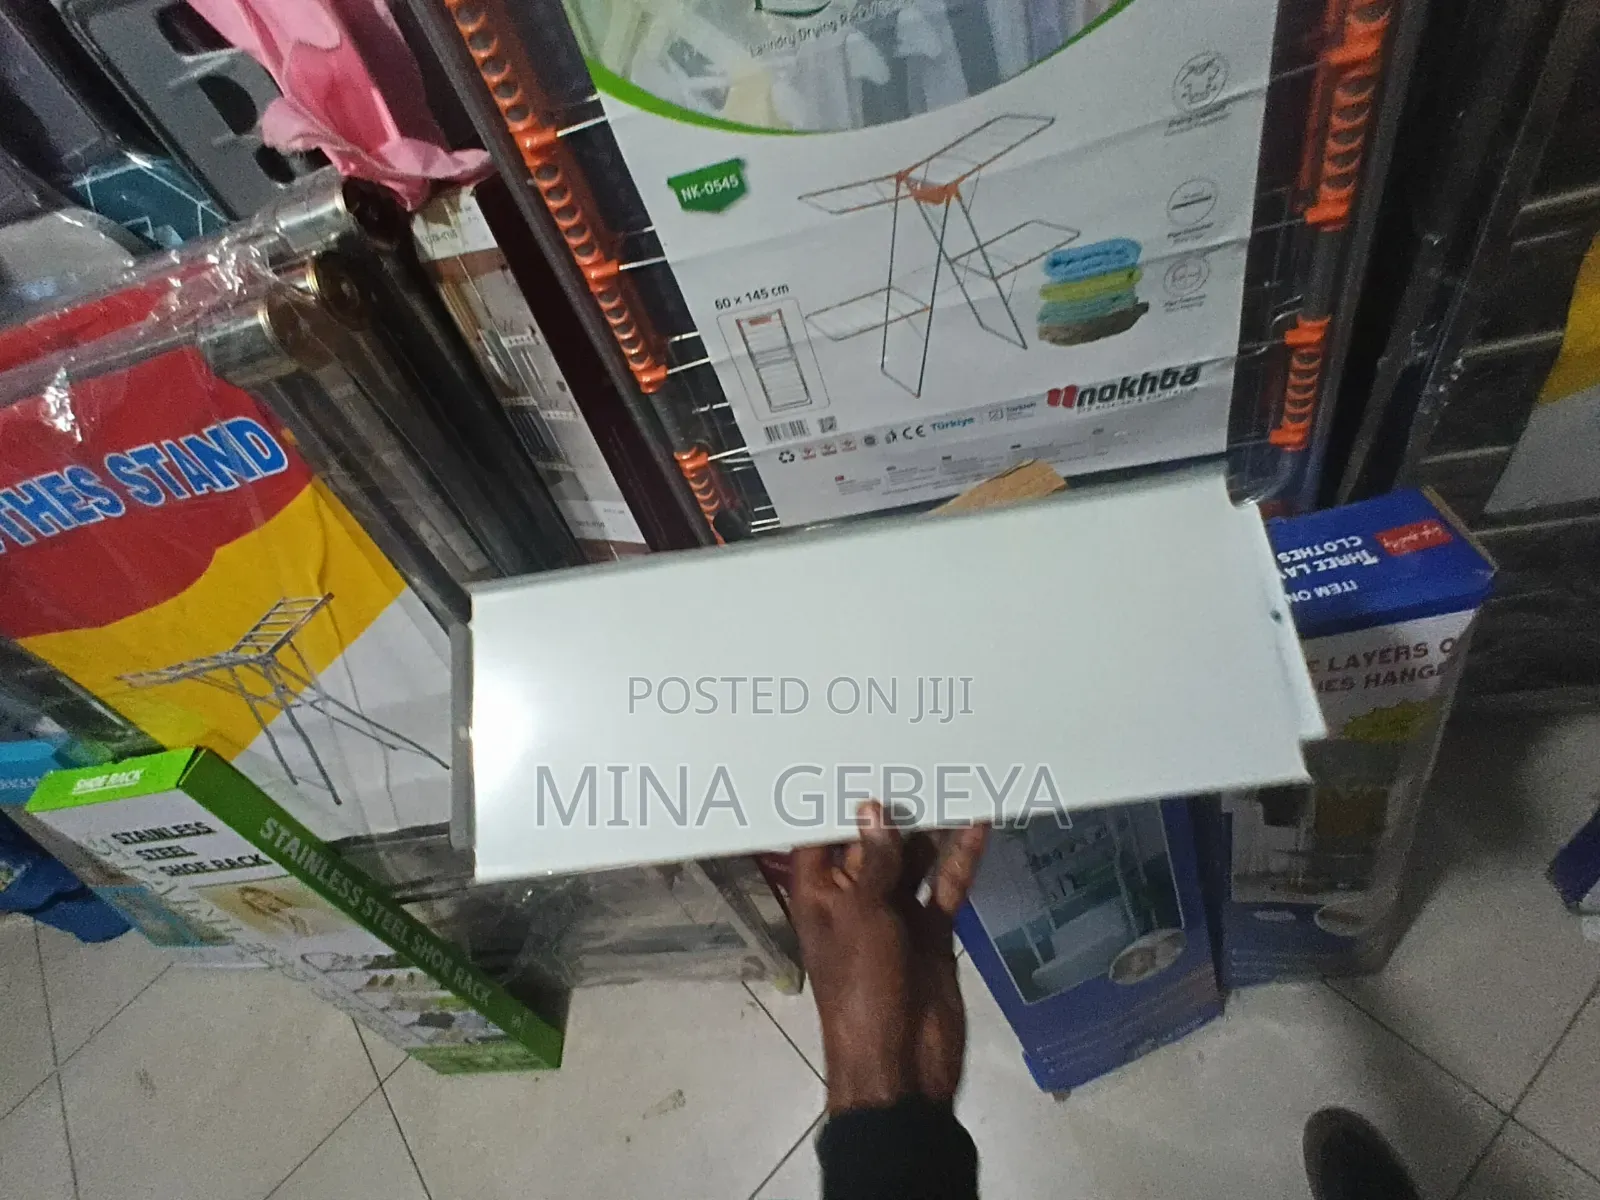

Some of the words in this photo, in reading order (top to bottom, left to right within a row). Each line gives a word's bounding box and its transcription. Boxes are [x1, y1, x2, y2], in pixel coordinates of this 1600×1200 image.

[680, 174, 740, 202] NK-0545
[715, 299, 732, 311] 60
[745, 288, 770, 303] 145
[771, 284, 790, 297] cm
[0, 464, 126, 556] THES
[104, 416, 288, 507] STAND
[1277, 535, 1363, 565] CLOTHES
[1313, 579, 1359, 599] ITEM
[1327, 642, 1429, 673] LAYERS
[111, 821, 217, 846] STAINLESS
[135, 845, 197, 862] STEEL
[158, 861, 212, 877] SHOE
[211, 854, 274, 872] RACK
[259, 816, 364, 907] STAINLESS
[363, 898, 410, 946] STEEL
[411, 935, 454, 977] SHOE
[452, 969, 494, 1007] RACK
